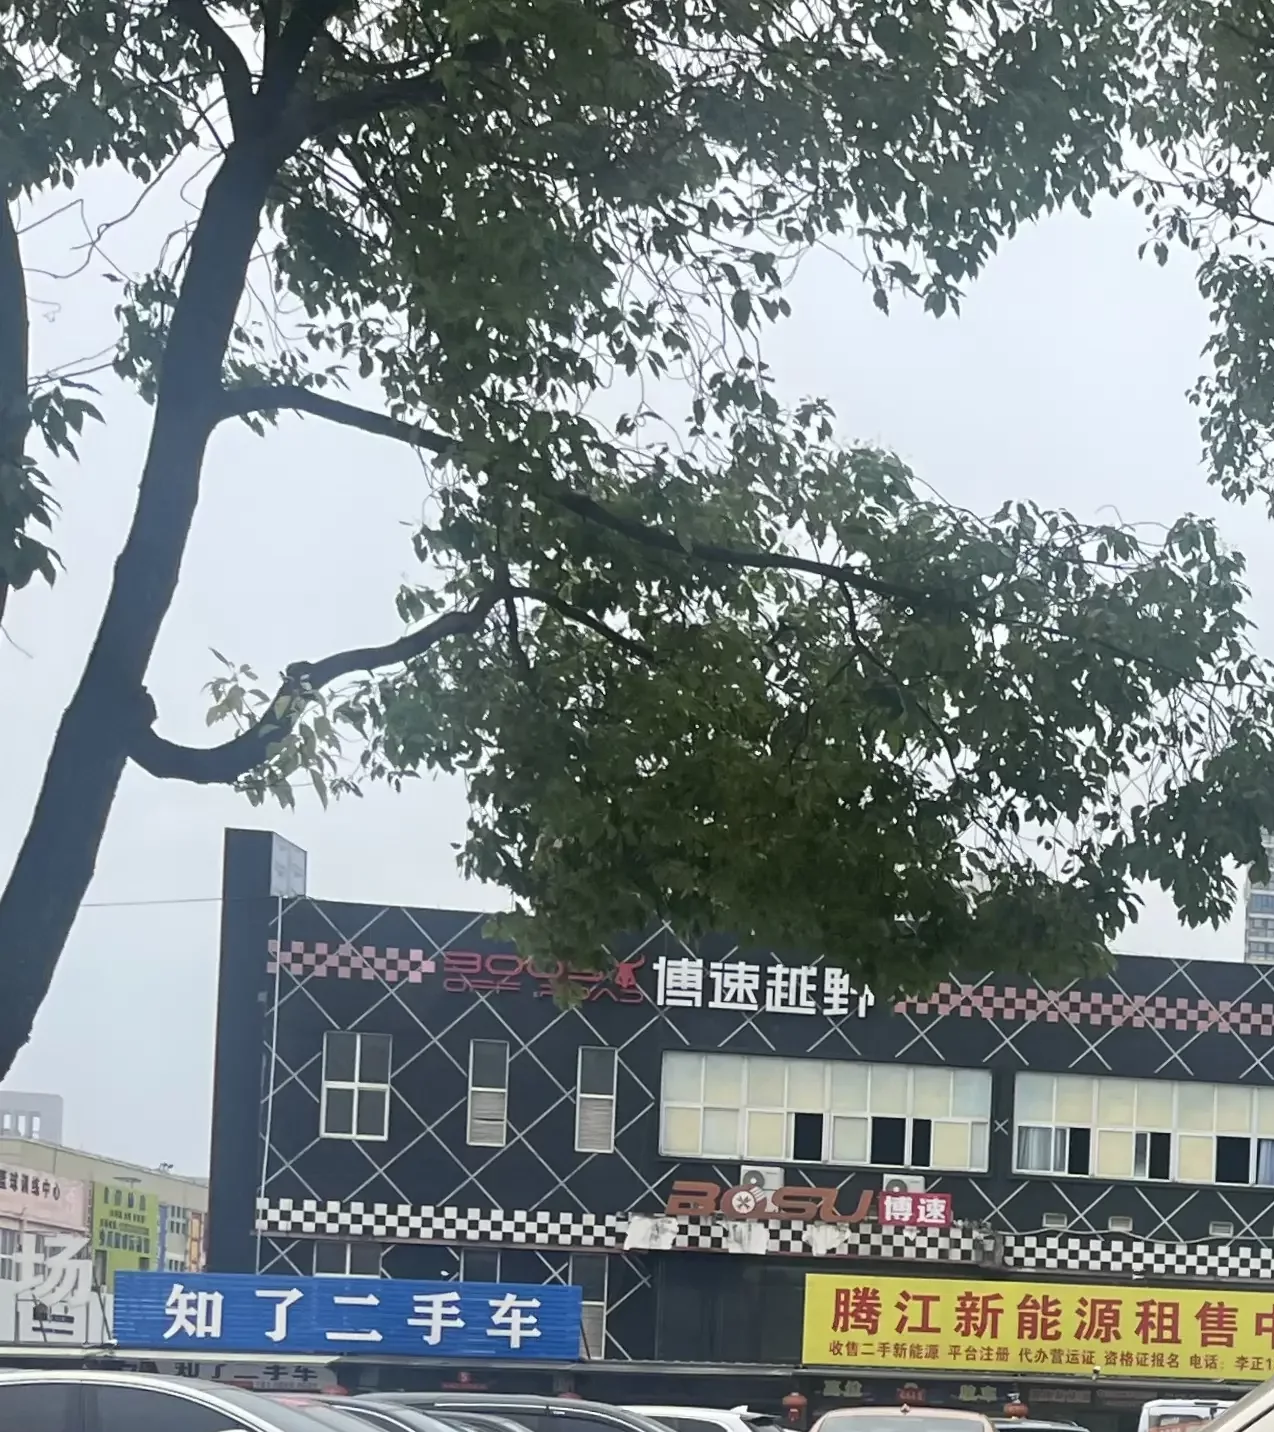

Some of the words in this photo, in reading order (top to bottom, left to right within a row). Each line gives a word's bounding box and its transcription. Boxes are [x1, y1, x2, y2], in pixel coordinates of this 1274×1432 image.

[652, 955, 875, 1018] 博速越野
[883, 1195, 948, 1225] 博速
[163, 1283, 542, 1349] 知了二手车
[829, 1340, 939, 1361] 收售二手新能源
[948, 1345, 1009, 1363] 平台注册
[1019, 1347, 1096, 1365] 代办营运证
[1104, 1350, 1180, 1369] 资格证报名
